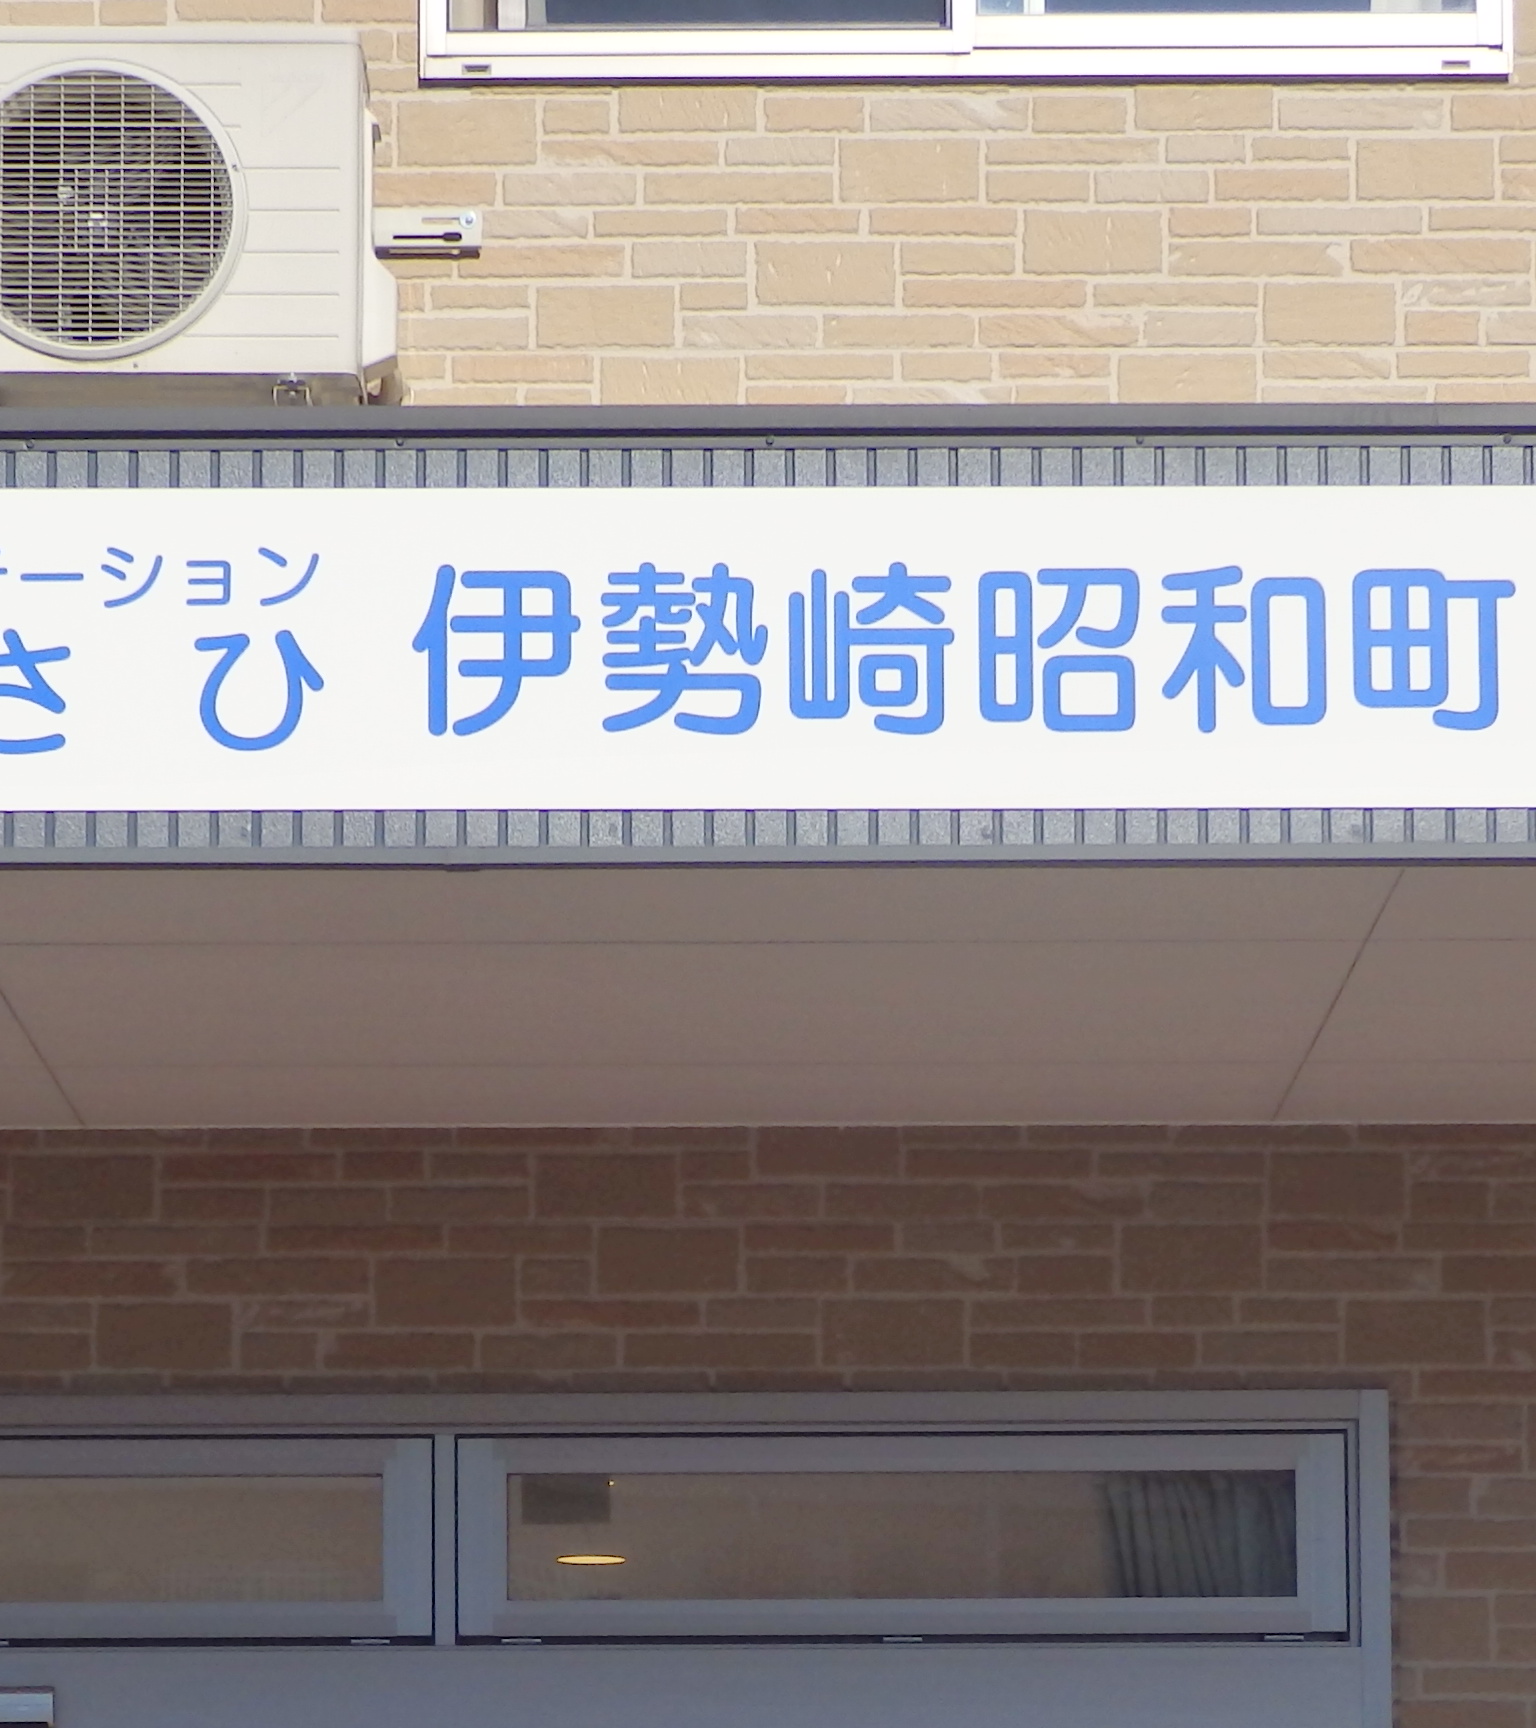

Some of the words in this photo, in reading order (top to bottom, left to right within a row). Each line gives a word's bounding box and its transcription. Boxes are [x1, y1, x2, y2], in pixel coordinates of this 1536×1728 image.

[411, 562, 1517, 738] 伊勢崎昭和町
